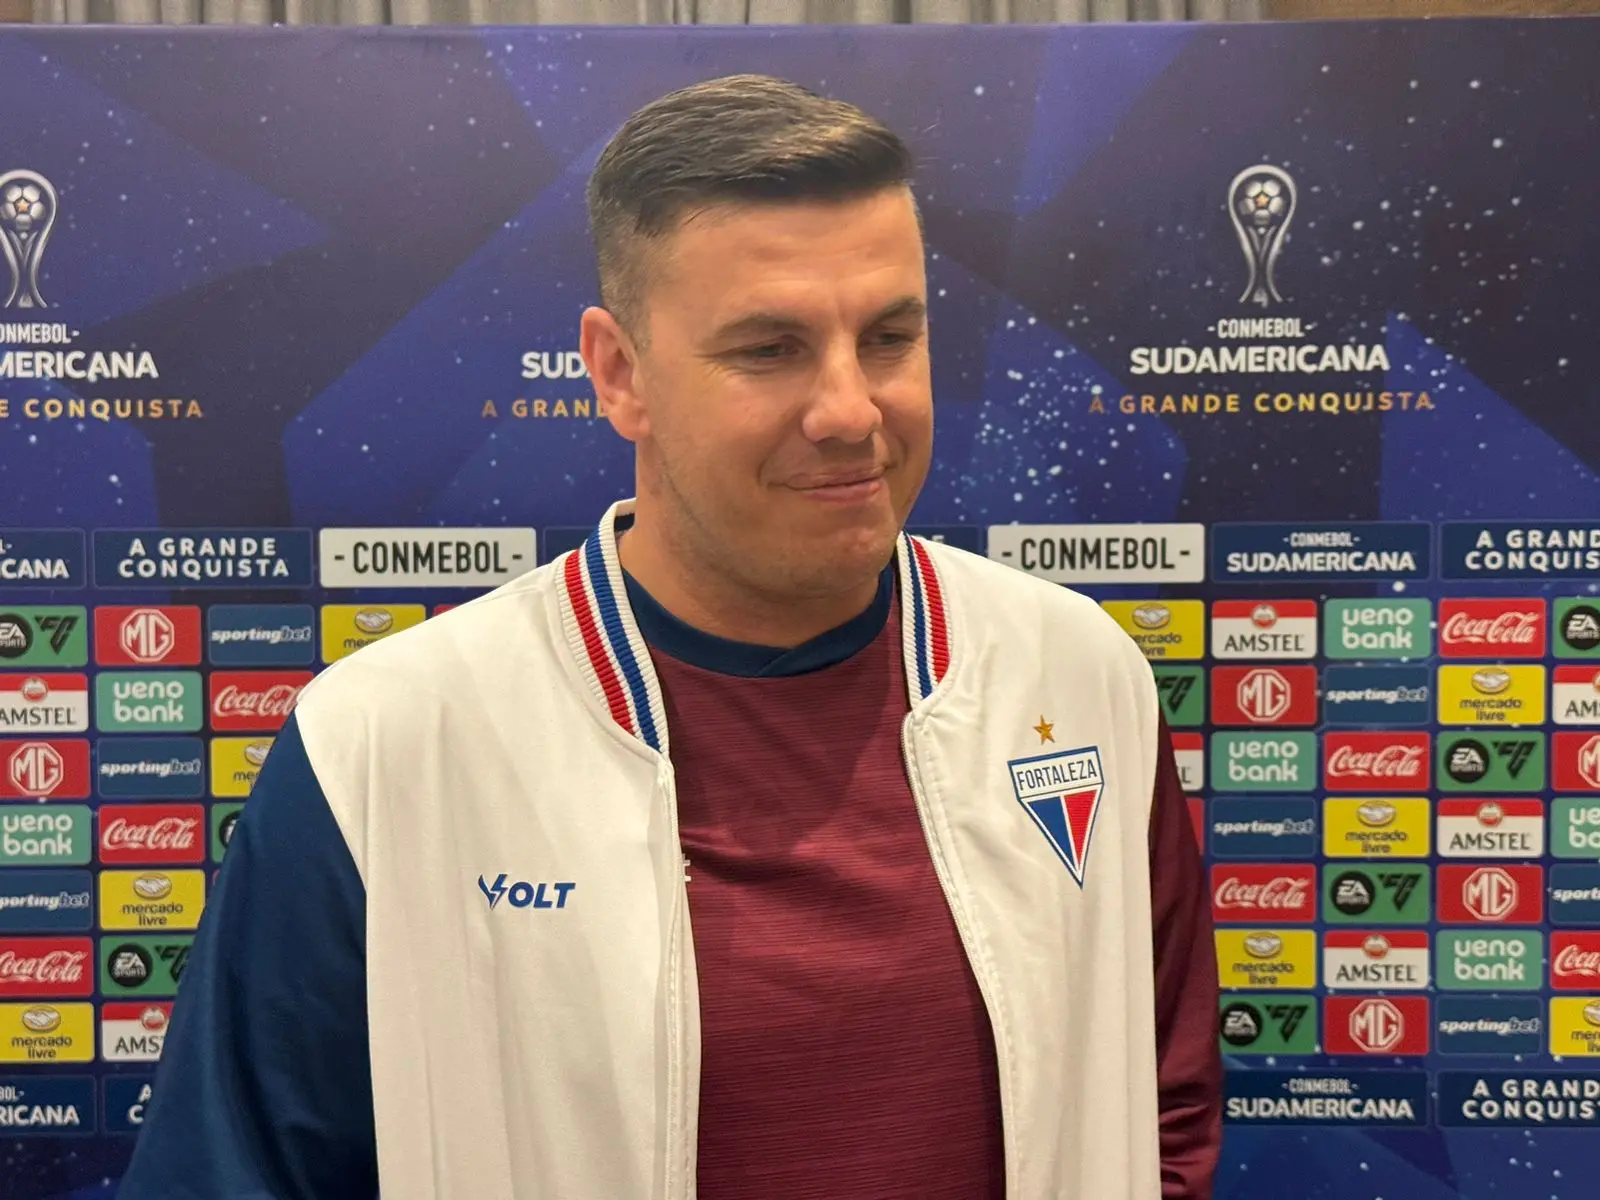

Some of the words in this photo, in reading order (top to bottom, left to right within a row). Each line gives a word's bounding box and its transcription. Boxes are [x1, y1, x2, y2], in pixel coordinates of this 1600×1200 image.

[1130, 345, 1390, 374] SUDAMERICANA
[24, 399, 202, 420] CONQUISTA
[482, 400, 498, 418] A
[1119, 394, 1241, 414] GRANDE
[1254, 391, 1432, 415] CONQUISTA
[129, 538, 146, 557] A
[158, 537, 277, 557] GRANDE
[1476, 529, 1495, 549] A
[1506, 529, 1600, 549] GRAND
[118, 558, 289, 580] CONQUISTA
[1227, 551, 1417, 573] SUDAMERICANA
[1465, 551, 1600, 573] CONQUIS
[1341, 608, 1413, 626] ueno
[126, 614, 170, 657] MG
[211, 626, 313, 645] sportingbet
[1224, 634, 1305, 652] AMSTEL
[1341, 628, 1412, 649] bank
[113, 680, 184, 699] ueno
[1242, 674, 1287, 718] MG
[1327, 685, 1428, 704] sportingbet
[113, 703, 184, 724] bank
[1228, 740, 1299, 760] ueno
[1451, 748, 1484, 763] EA
[17, 747, 60, 790] MG
[100, 759, 201, 778] sportingbet
[1016, 759, 1098, 791] FORTALEZA
[1228, 761, 1299, 782] bank
[2, 813, 73, 833] ueno
[3, 833, 73, 856] bank
[1449, 832, 1531, 851] AMSTEL
[478, 872, 577, 912] VOLT
[1337, 879, 1368, 896] EA
[1468, 871, 1513, 916] MG
[1454, 939, 1525, 958] ueno
[114, 952, 146, 966] EA
[1336, 964, 1418, 983] AMSTEL
[1454, 958, 1524, 981] bank
[1226, 1010, 1256, 1027] EA
[1353, 1002, 1399, 1048] MG
[1439, 1016, 1541, 1036] sportingbet
[1472, 1078, 1490, 1098] A
[1502, 1078, 1600, 1098] GRAND
[1226, 1097, 1415, 1120] SUDAMERICANA
[1462, 1099, 1600, 1122] CONQUIS
